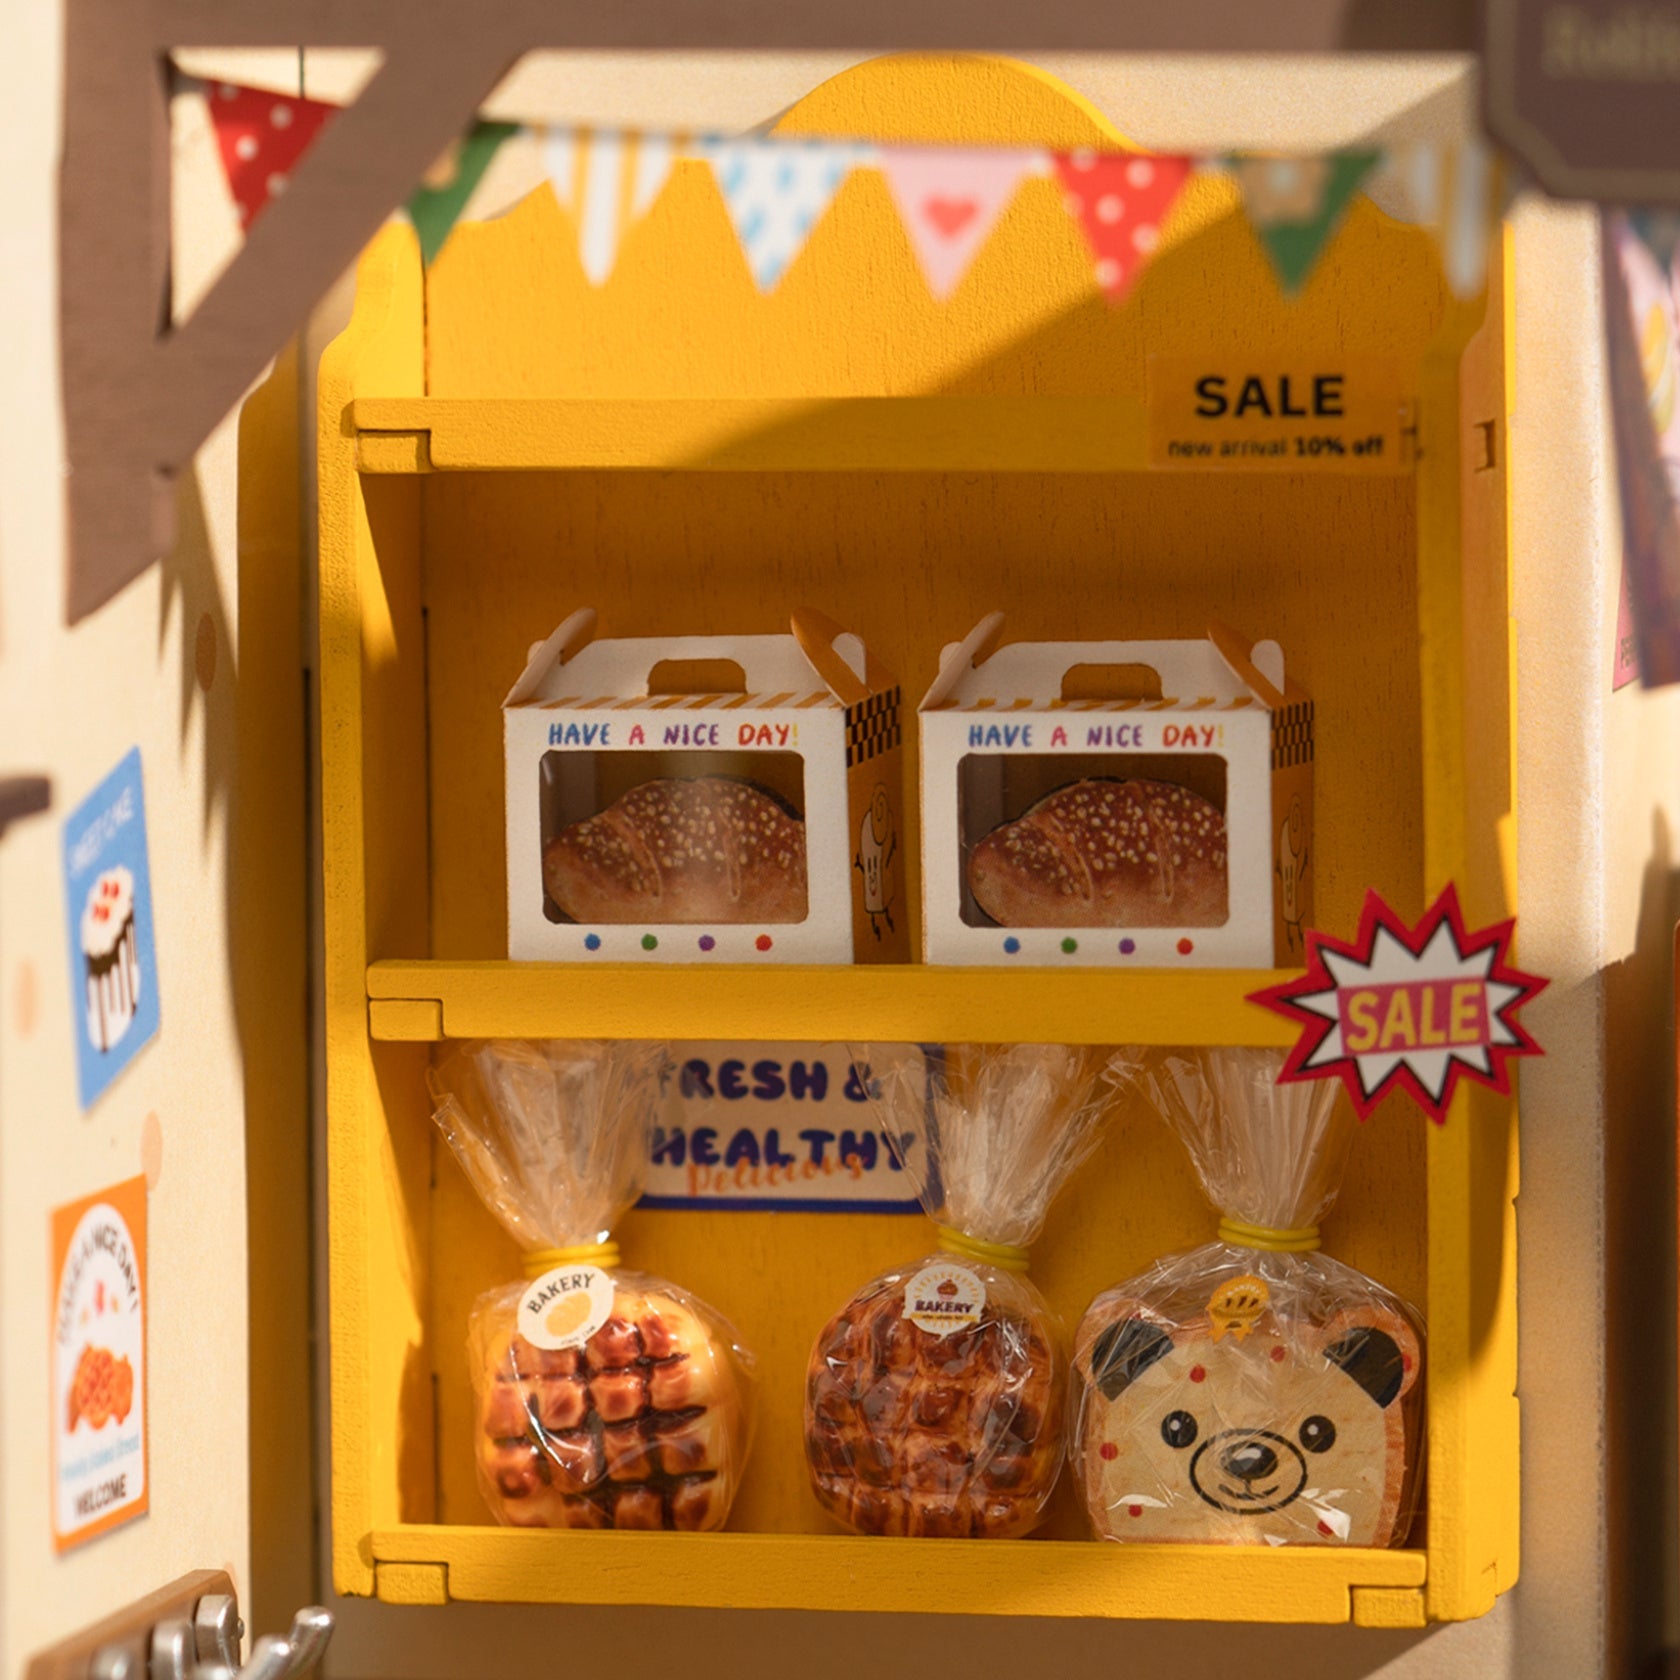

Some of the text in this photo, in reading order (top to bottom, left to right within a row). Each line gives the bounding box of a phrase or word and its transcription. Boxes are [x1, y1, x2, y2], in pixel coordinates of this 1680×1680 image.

[1194, 374, 1344, 417] SALE
[1168, 435, 1384, 457] new arrival 10% off
[548, 722, 800, 747] HAVE A NICE DAY!
[968, 724, 1225, 748] HAVE A NICE DAY!
[1345, 982, 1483, 1052] SALE
[843, 1060, 883, 1103] &
[651, 1127, 915, 1171] HEALTHY
[526, 1272, 596, 1314] BAKERY
[914, 1299, 974, 1313] BAKERY
